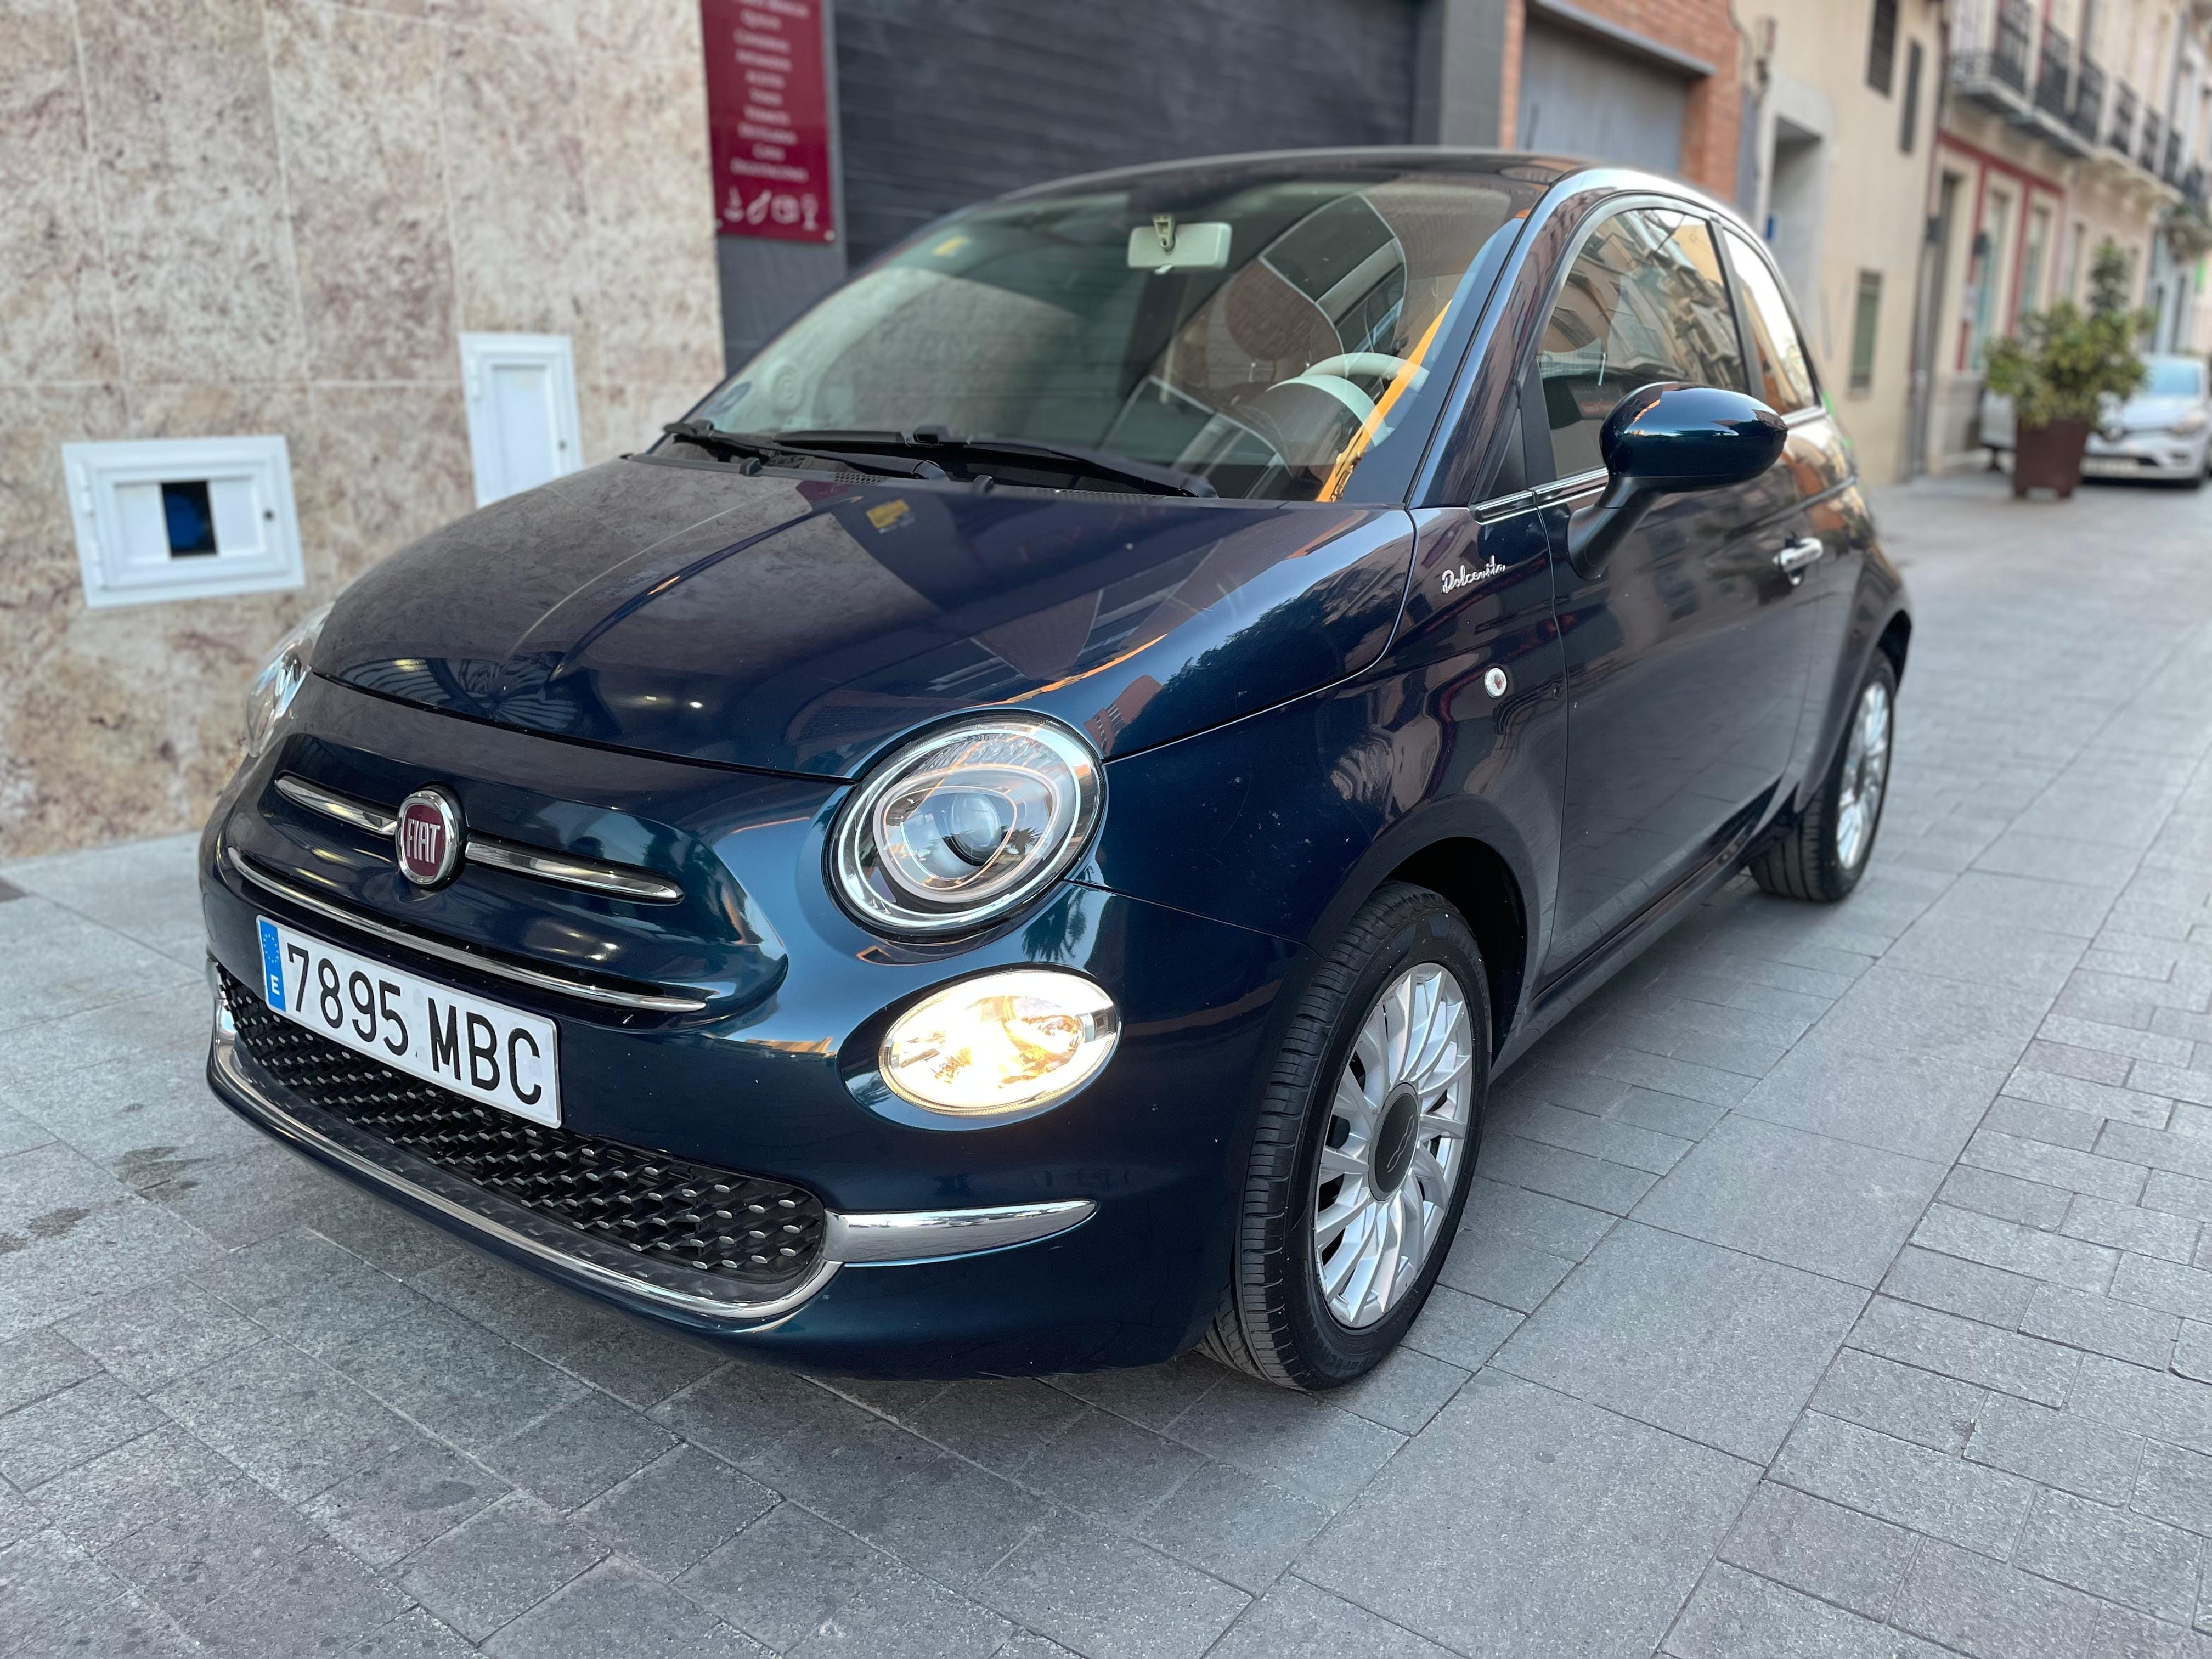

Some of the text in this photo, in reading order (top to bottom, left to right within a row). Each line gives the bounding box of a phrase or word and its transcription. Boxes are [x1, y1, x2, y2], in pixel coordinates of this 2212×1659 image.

[407, 818, 441, 864] FIAT
[270, 974, 280, 995] E
[287, 943, 541, 1105] 7895 MBC
